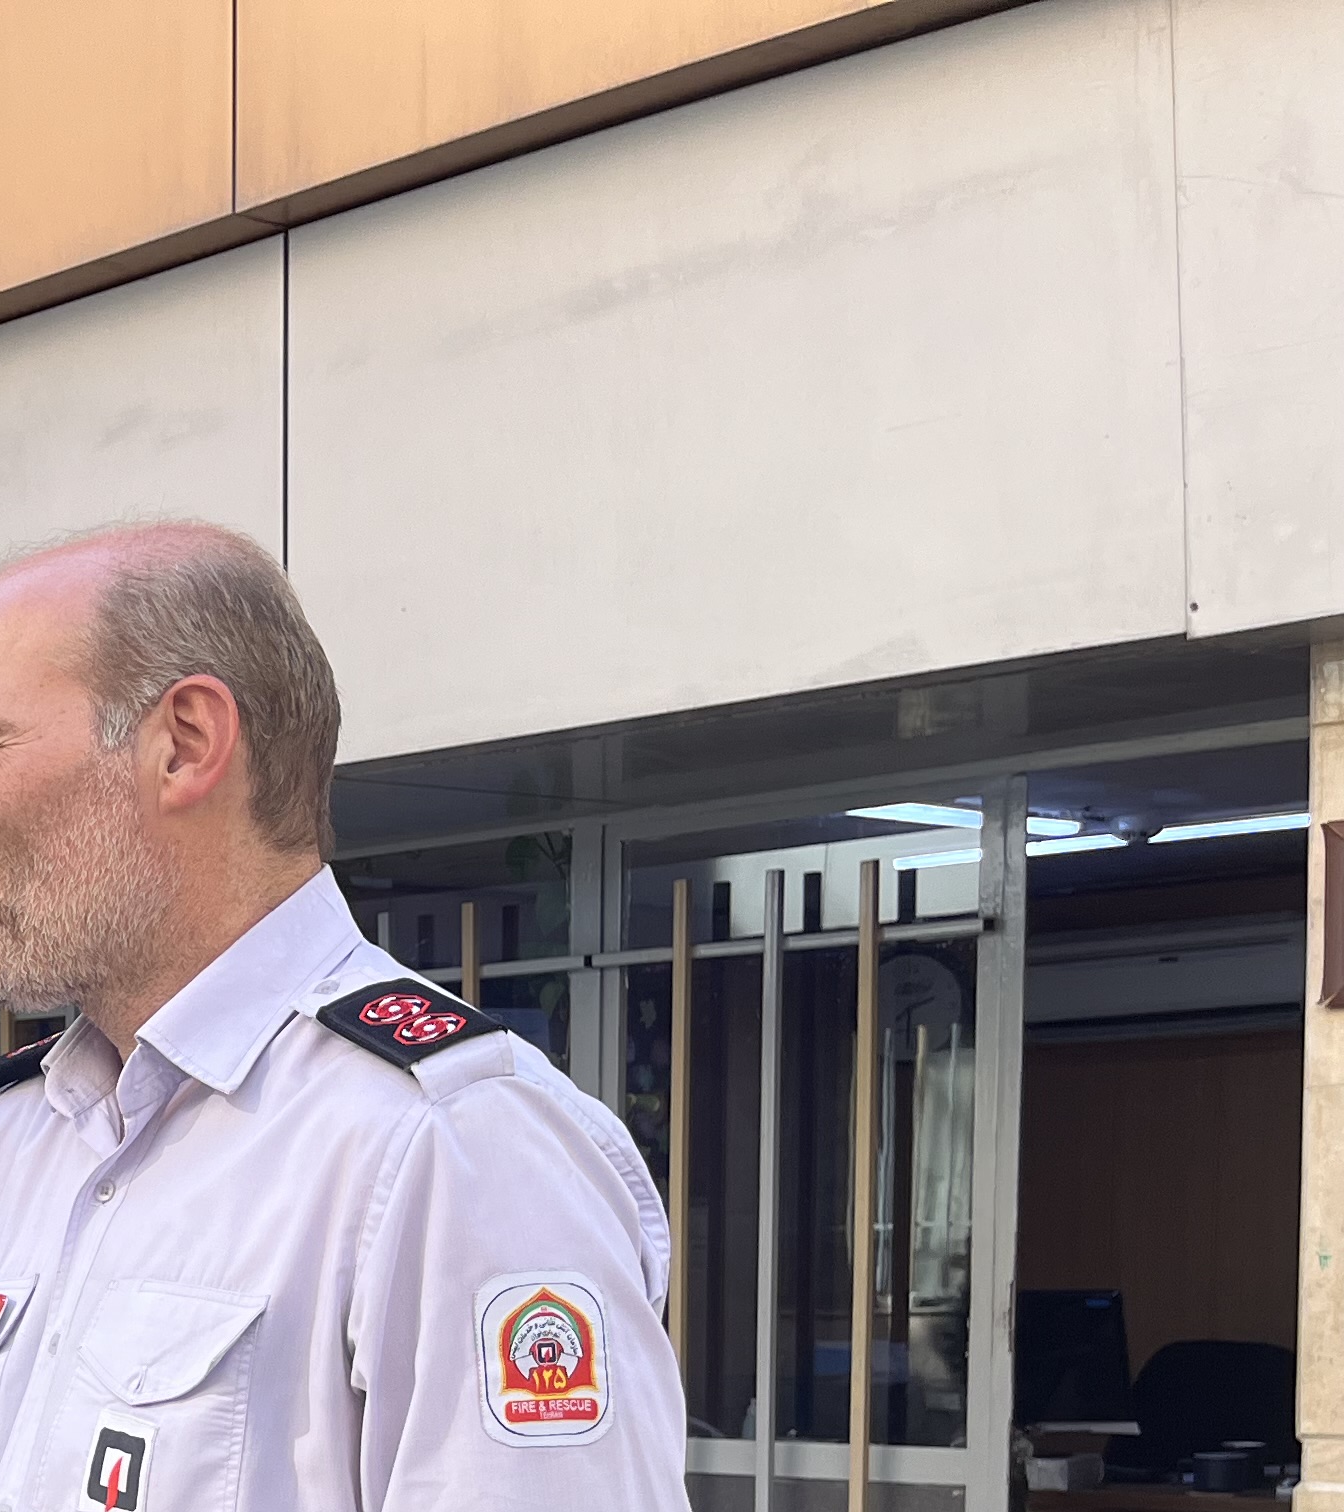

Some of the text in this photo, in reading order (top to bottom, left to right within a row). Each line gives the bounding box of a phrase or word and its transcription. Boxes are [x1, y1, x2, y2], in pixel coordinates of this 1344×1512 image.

[532, 1366, 567, 1392] ۱۲۵
[512, 1400, 592, 1414] FIRE & RESCUE
